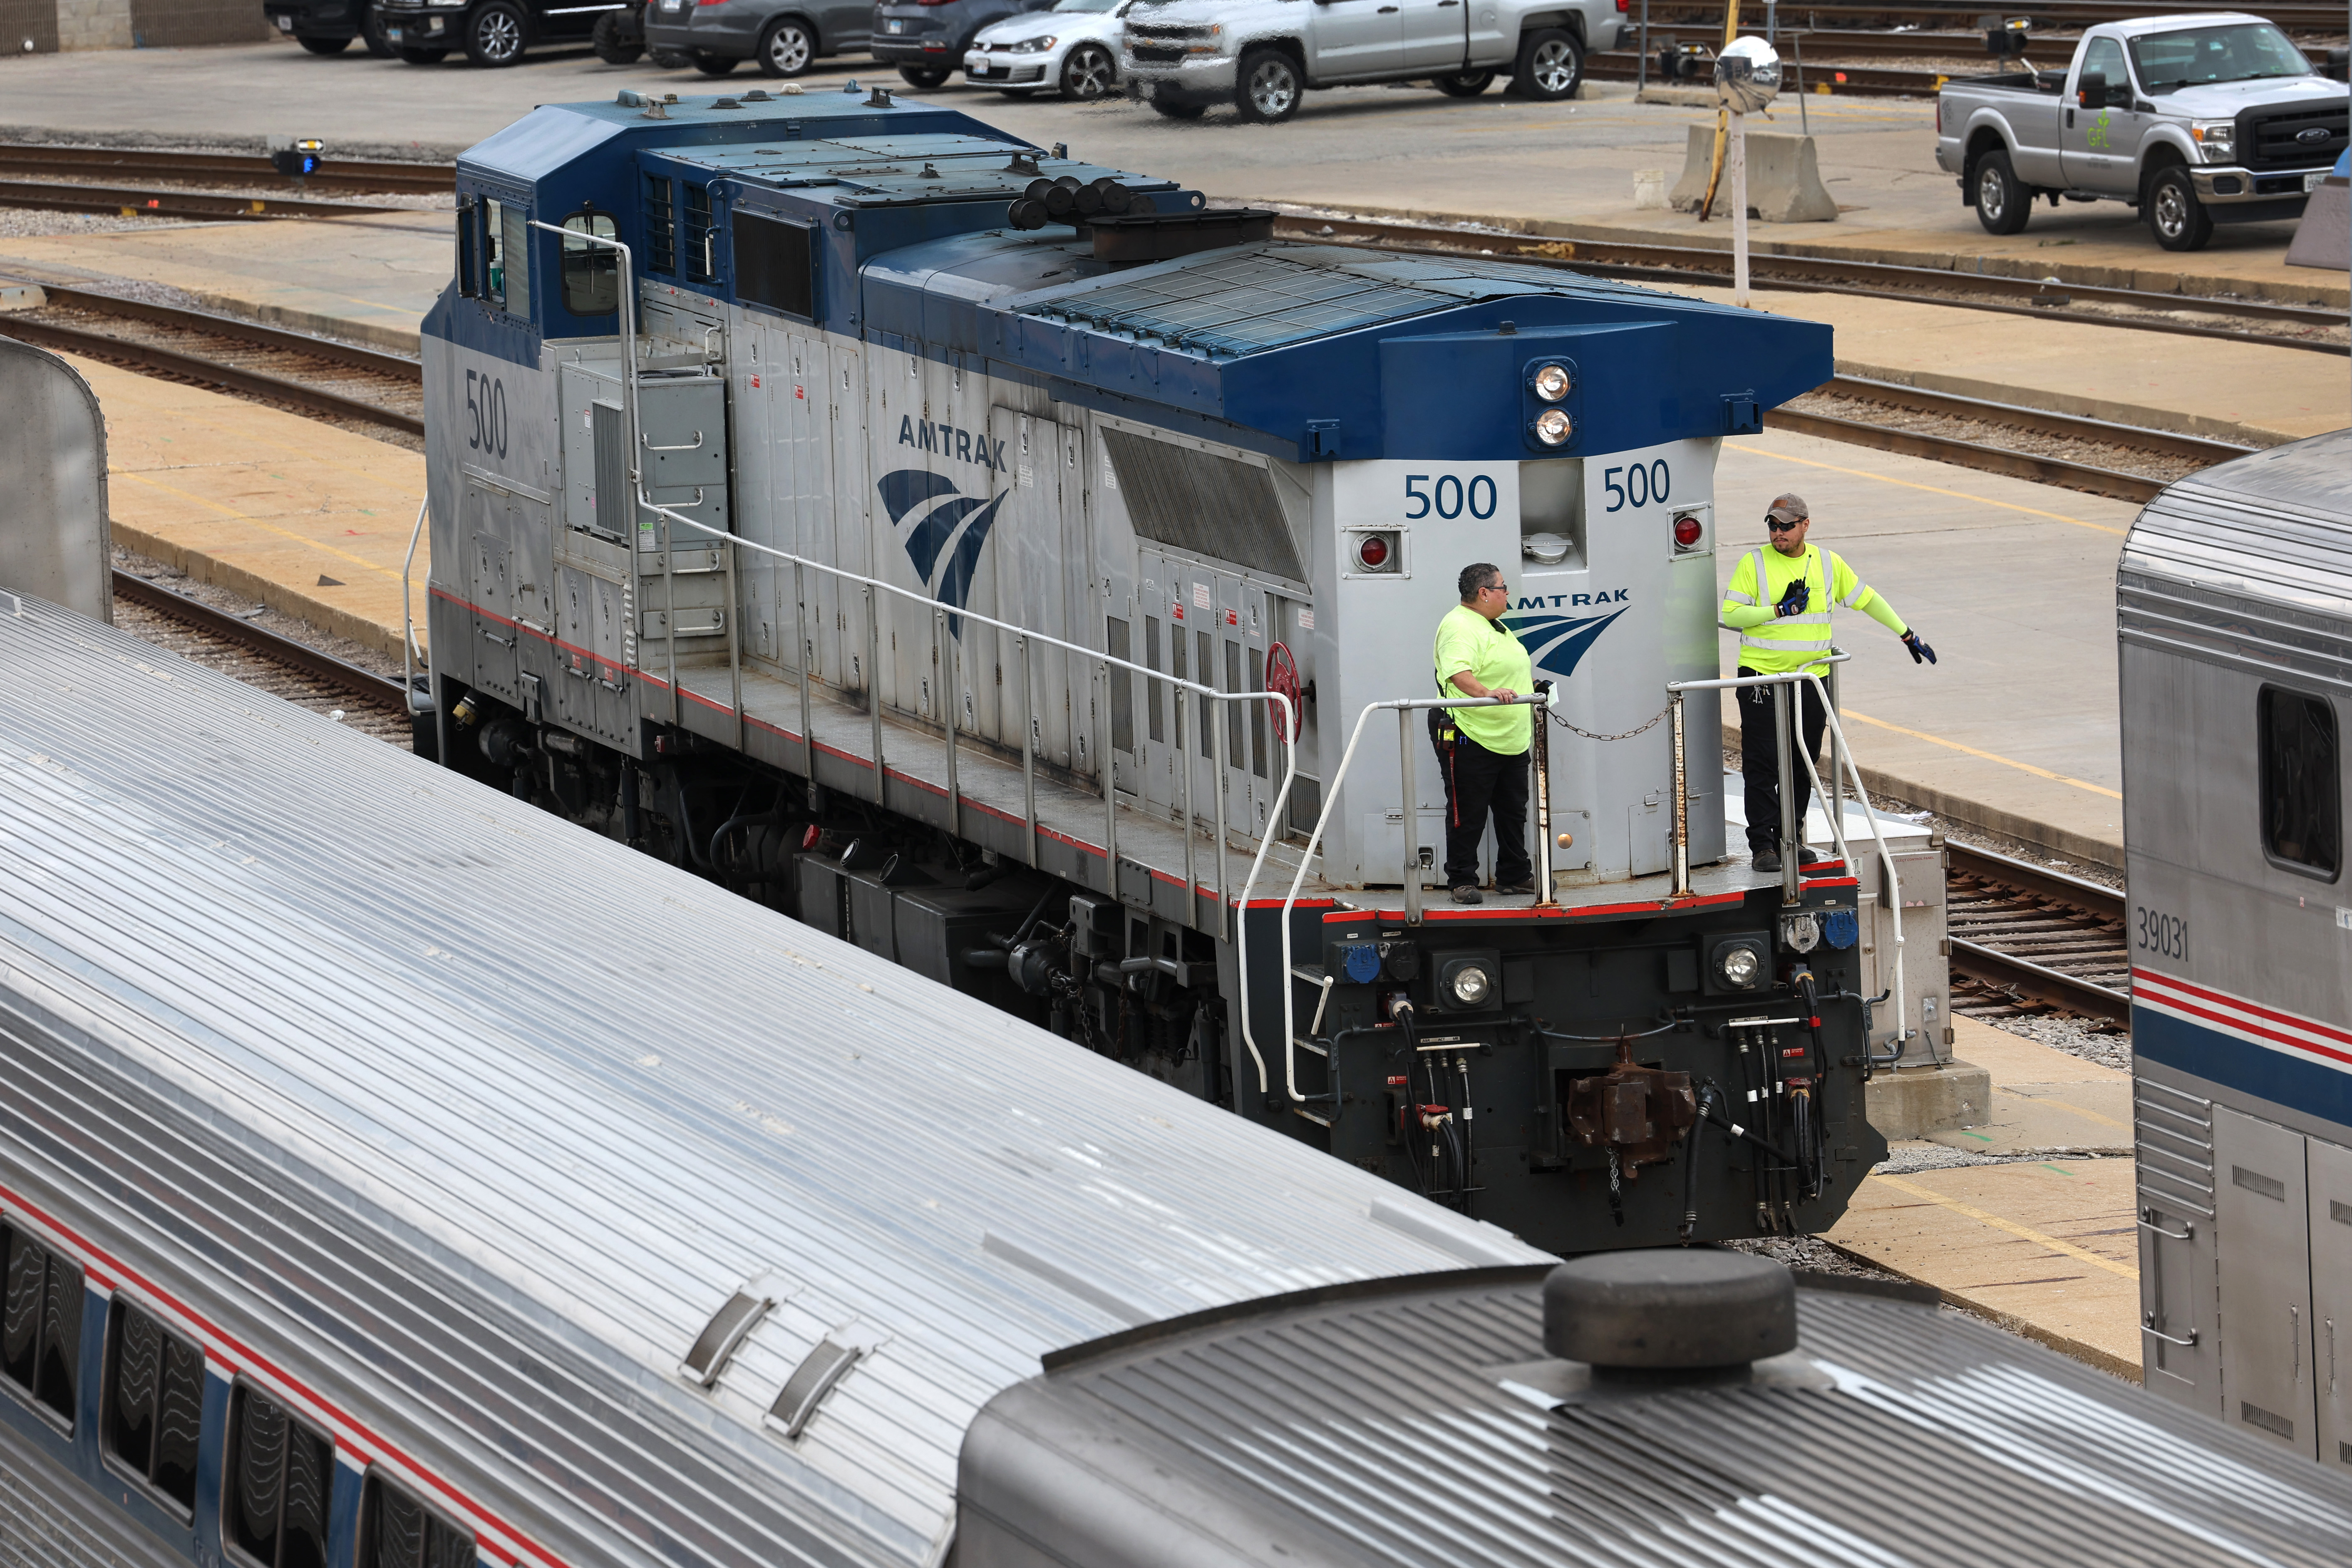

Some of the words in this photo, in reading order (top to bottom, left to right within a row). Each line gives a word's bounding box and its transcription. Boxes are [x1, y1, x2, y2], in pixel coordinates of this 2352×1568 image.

[2087, 118, 2110, 148] GFL
[466, 369, 507, 460] 500
[898, 414, 1007, 473] AMTRAK
[1405, 474, 1497, 520] 500
[1605, 459, 1670, 513] 500
[1853, 858, 1861, 874] 1
[2138, 906, 2188, 962] 39031
